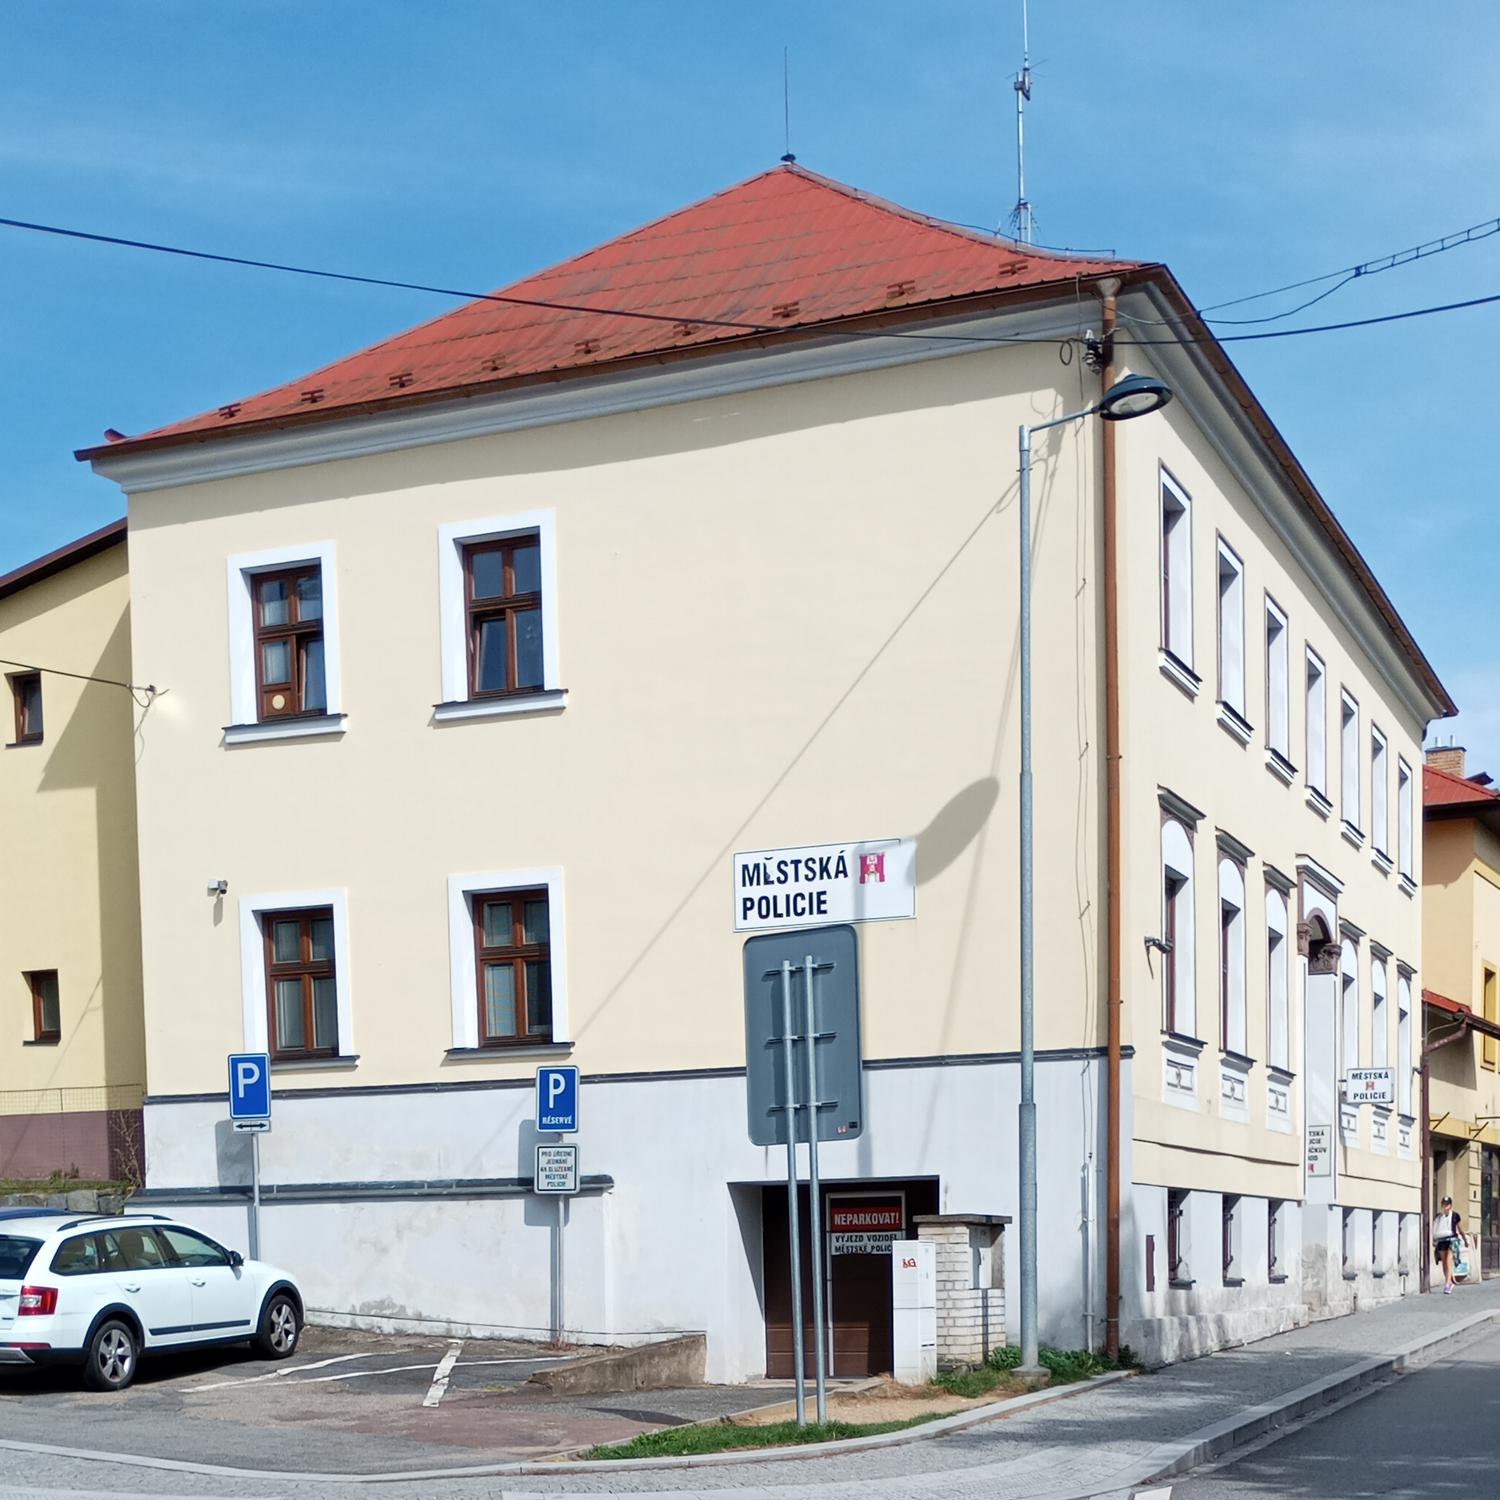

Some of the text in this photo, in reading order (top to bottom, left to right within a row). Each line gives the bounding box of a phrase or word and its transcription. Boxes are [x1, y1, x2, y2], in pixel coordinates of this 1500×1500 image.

[741, 850, 849, 887] MĚSTSKÁ
[742, 890, 828, 920] POLICIE
[237, 1062, 260, 1098] P
[548, 1073, 566, 1109] P
[1353, 1091, 1386, 1100] POLICIE
[834, 1212, 899, 1225] NEPARKOVAT!
[867, 1233, 898, 1242] VOZIDEL
[871, 1244, 892, 1253] POLIC
